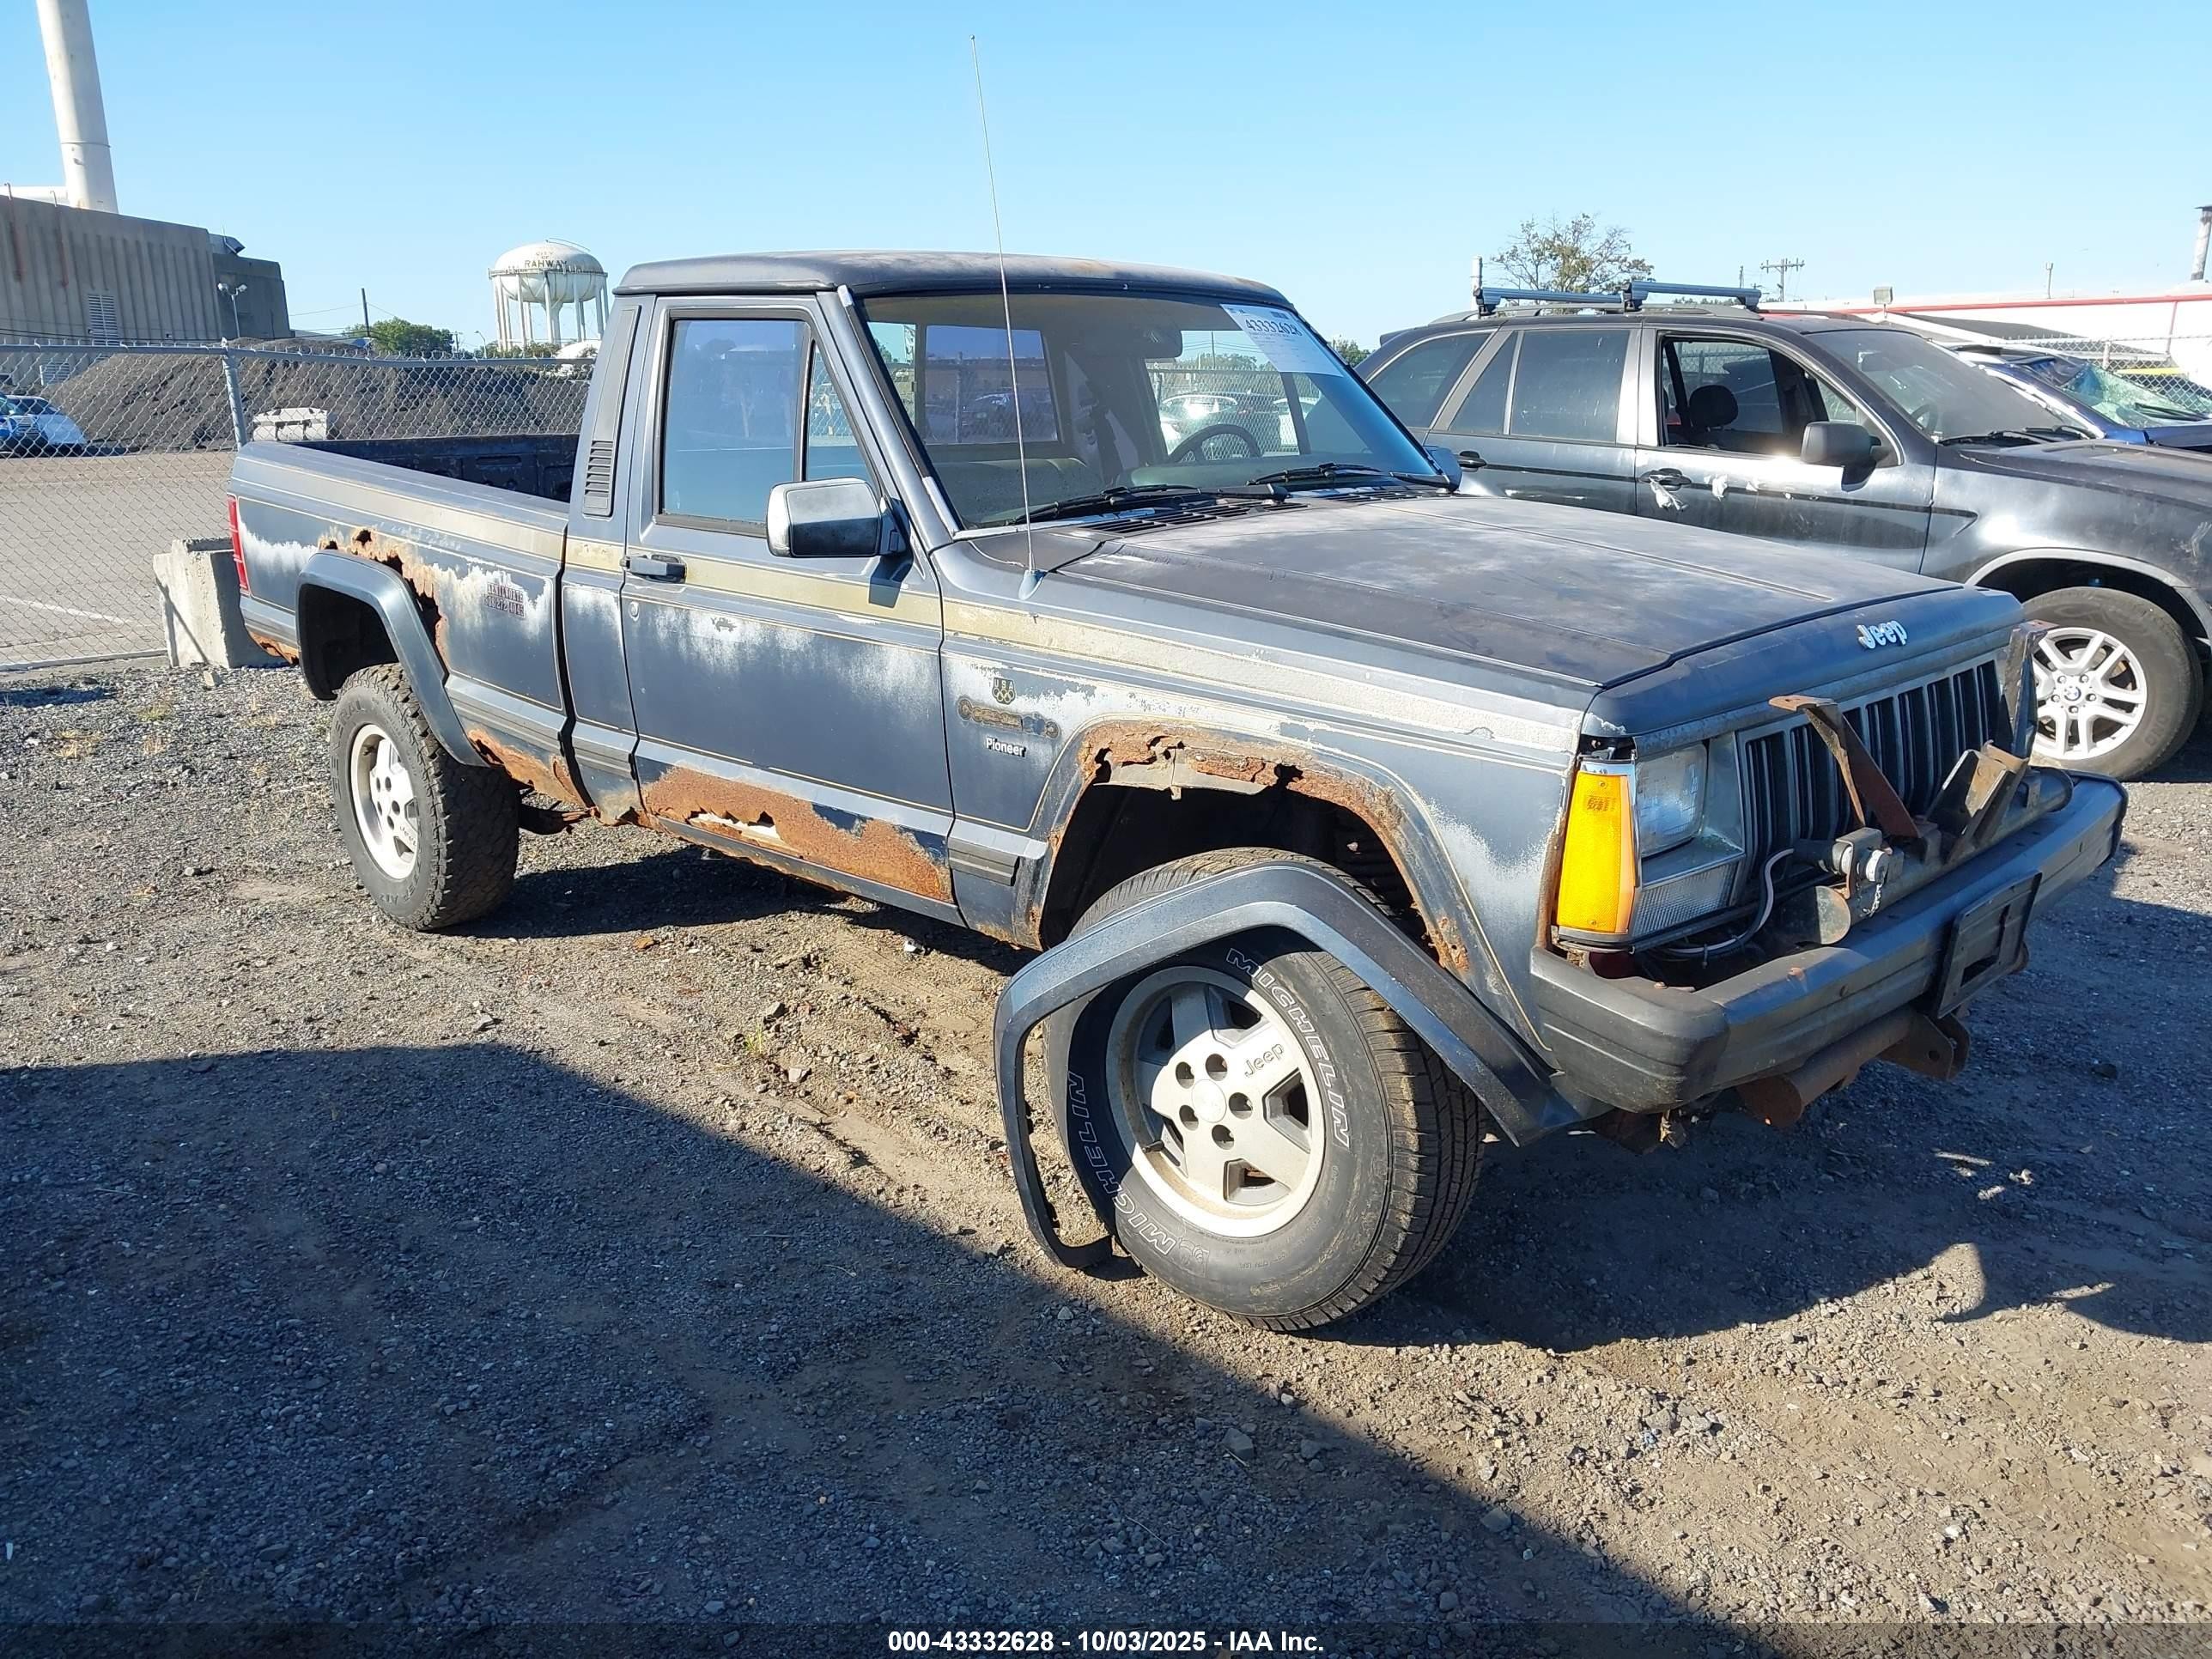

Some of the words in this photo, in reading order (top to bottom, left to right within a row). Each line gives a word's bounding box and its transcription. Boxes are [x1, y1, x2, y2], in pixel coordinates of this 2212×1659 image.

[525, 259, 567, 268] RAHWAY
[1245, 319, 1303, 336] 43332628
[1857, 620, 1908, 649] Jeep
[993, 679, 1014, 690] USA
[986, 737, 1025, 757] Pioneer
[1225, 948, 1352, 1152] MICHELIN
[1243, 1042, 1286, 1079] Jeep
[1067, 1070, 1177, 1255] MICHELIN
